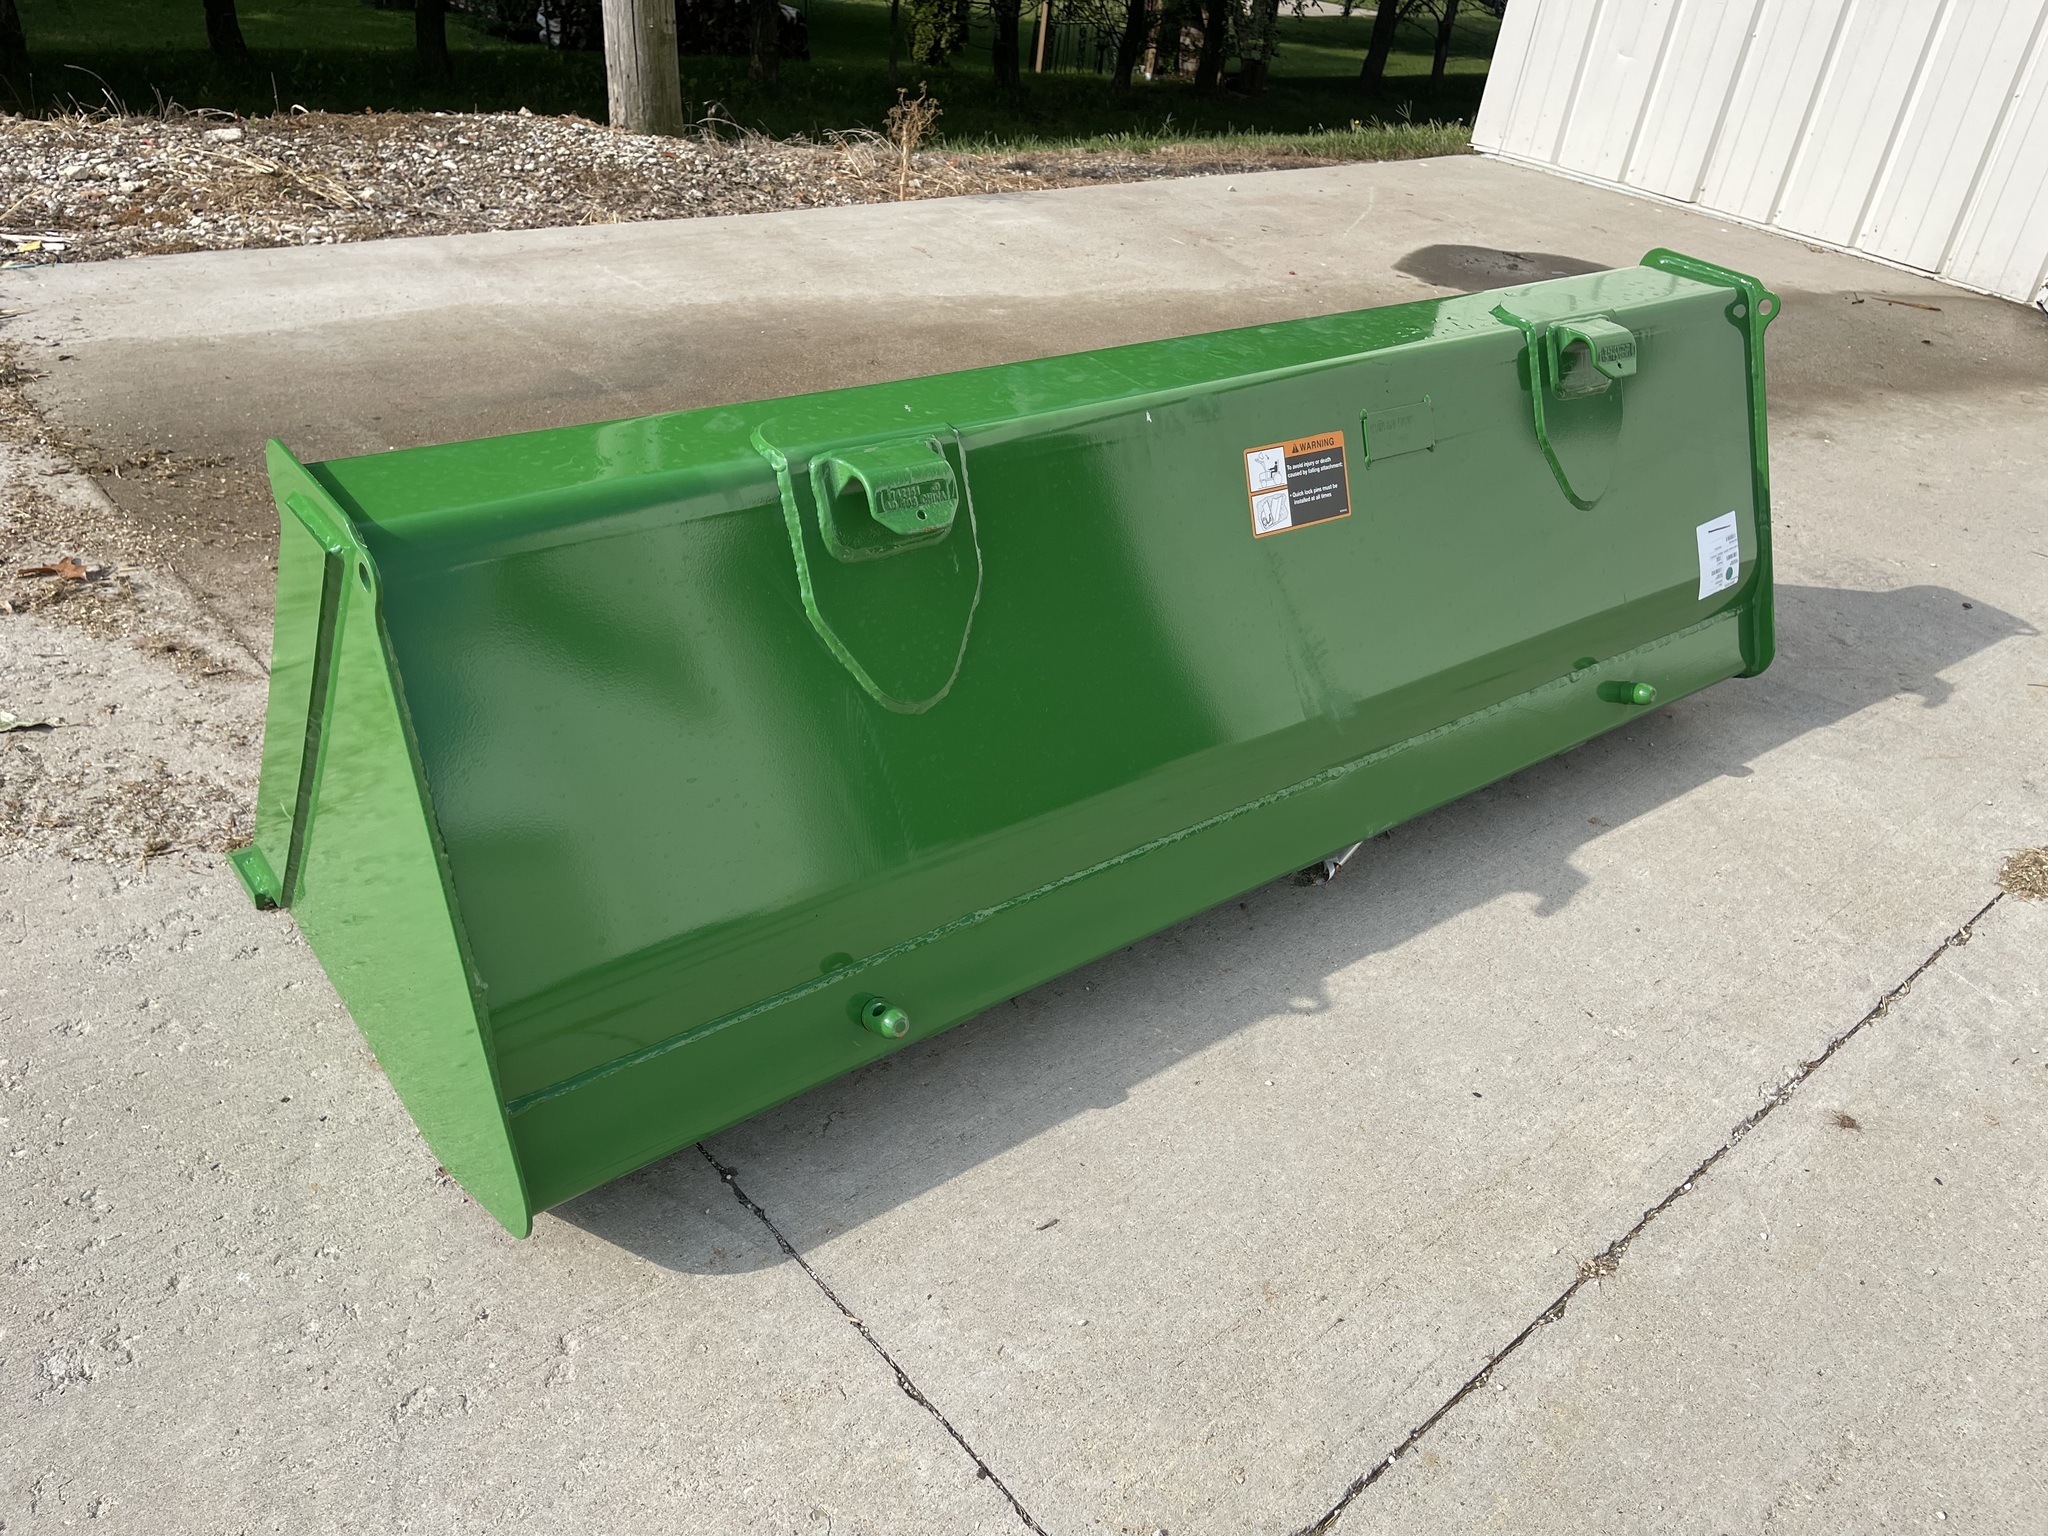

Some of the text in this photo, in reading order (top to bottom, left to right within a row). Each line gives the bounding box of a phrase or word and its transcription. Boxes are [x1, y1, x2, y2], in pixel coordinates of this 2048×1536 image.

[1299, 437, 1334, 451] WARNING
[1304, 460, 1315, 468] injury
[1287, 470, 1302, 478] caused
[1308, 466, 1320, 474] falling
[1292, 490, 1304, 498] Quick
[1293, 497, 1310, 505] installed
